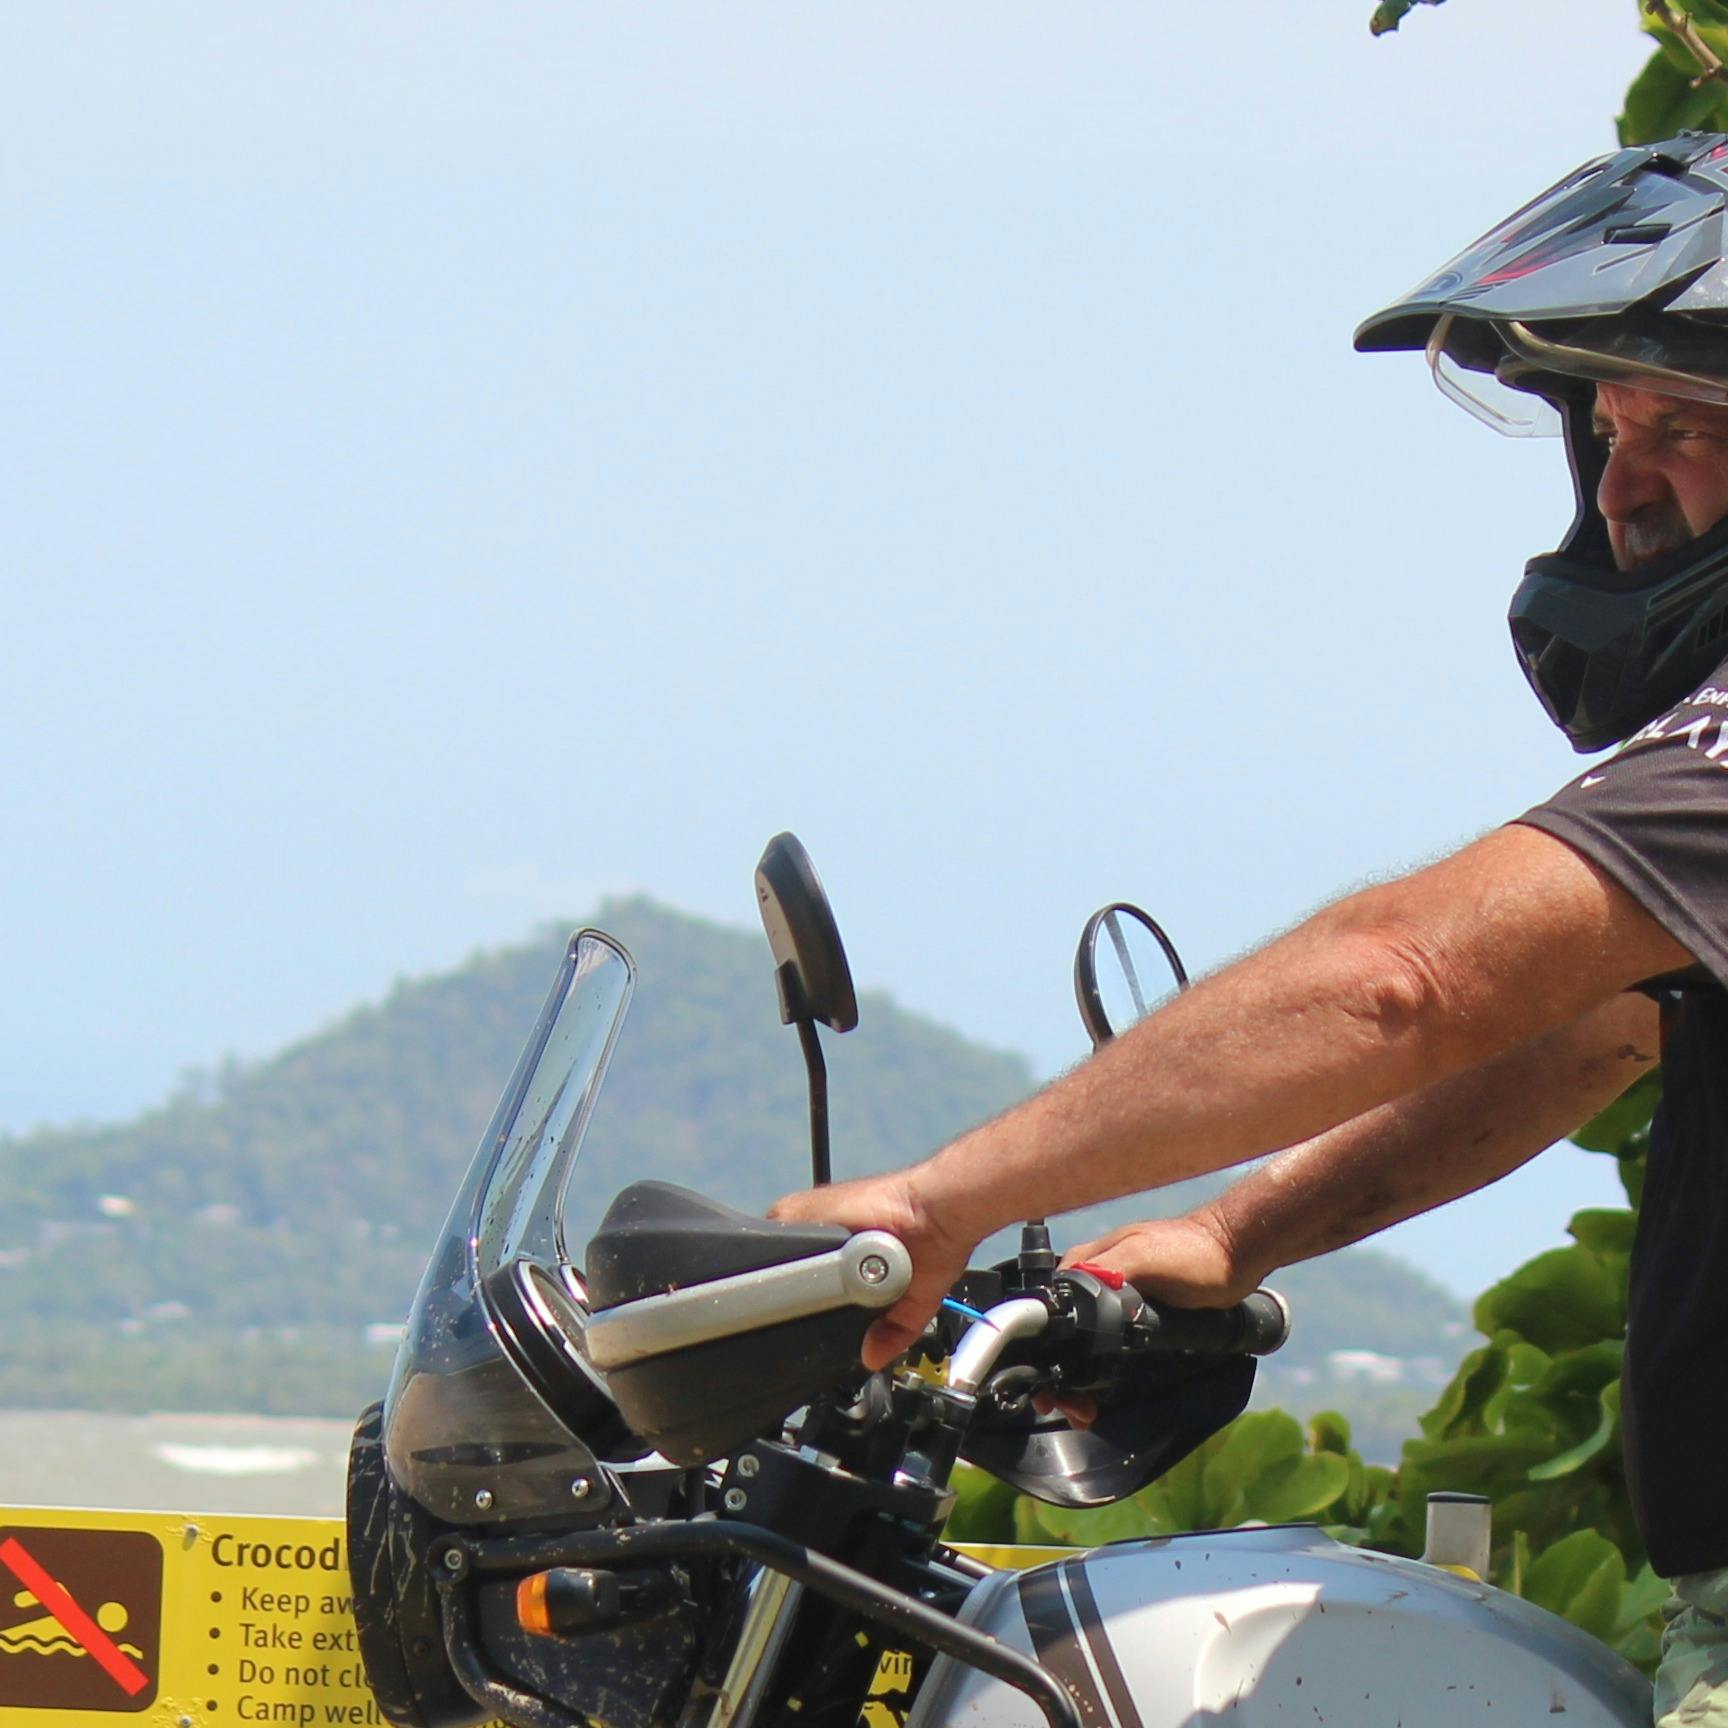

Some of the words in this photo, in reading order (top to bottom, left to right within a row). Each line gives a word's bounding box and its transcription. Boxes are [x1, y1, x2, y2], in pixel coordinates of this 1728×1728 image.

[211, 1534, 348, 1572] Crocod
[241, 1586, 311, 1618] Keep
[240, 1623, 303, 1649] Take
[313, 1629, 359, 1652] ext
[239, 1660, 275, 1685] Do
[285, 1663, 330, 1688] not
[237, 1696, 315, 1728] Camp
[325, 1700, 381, 1726] well
